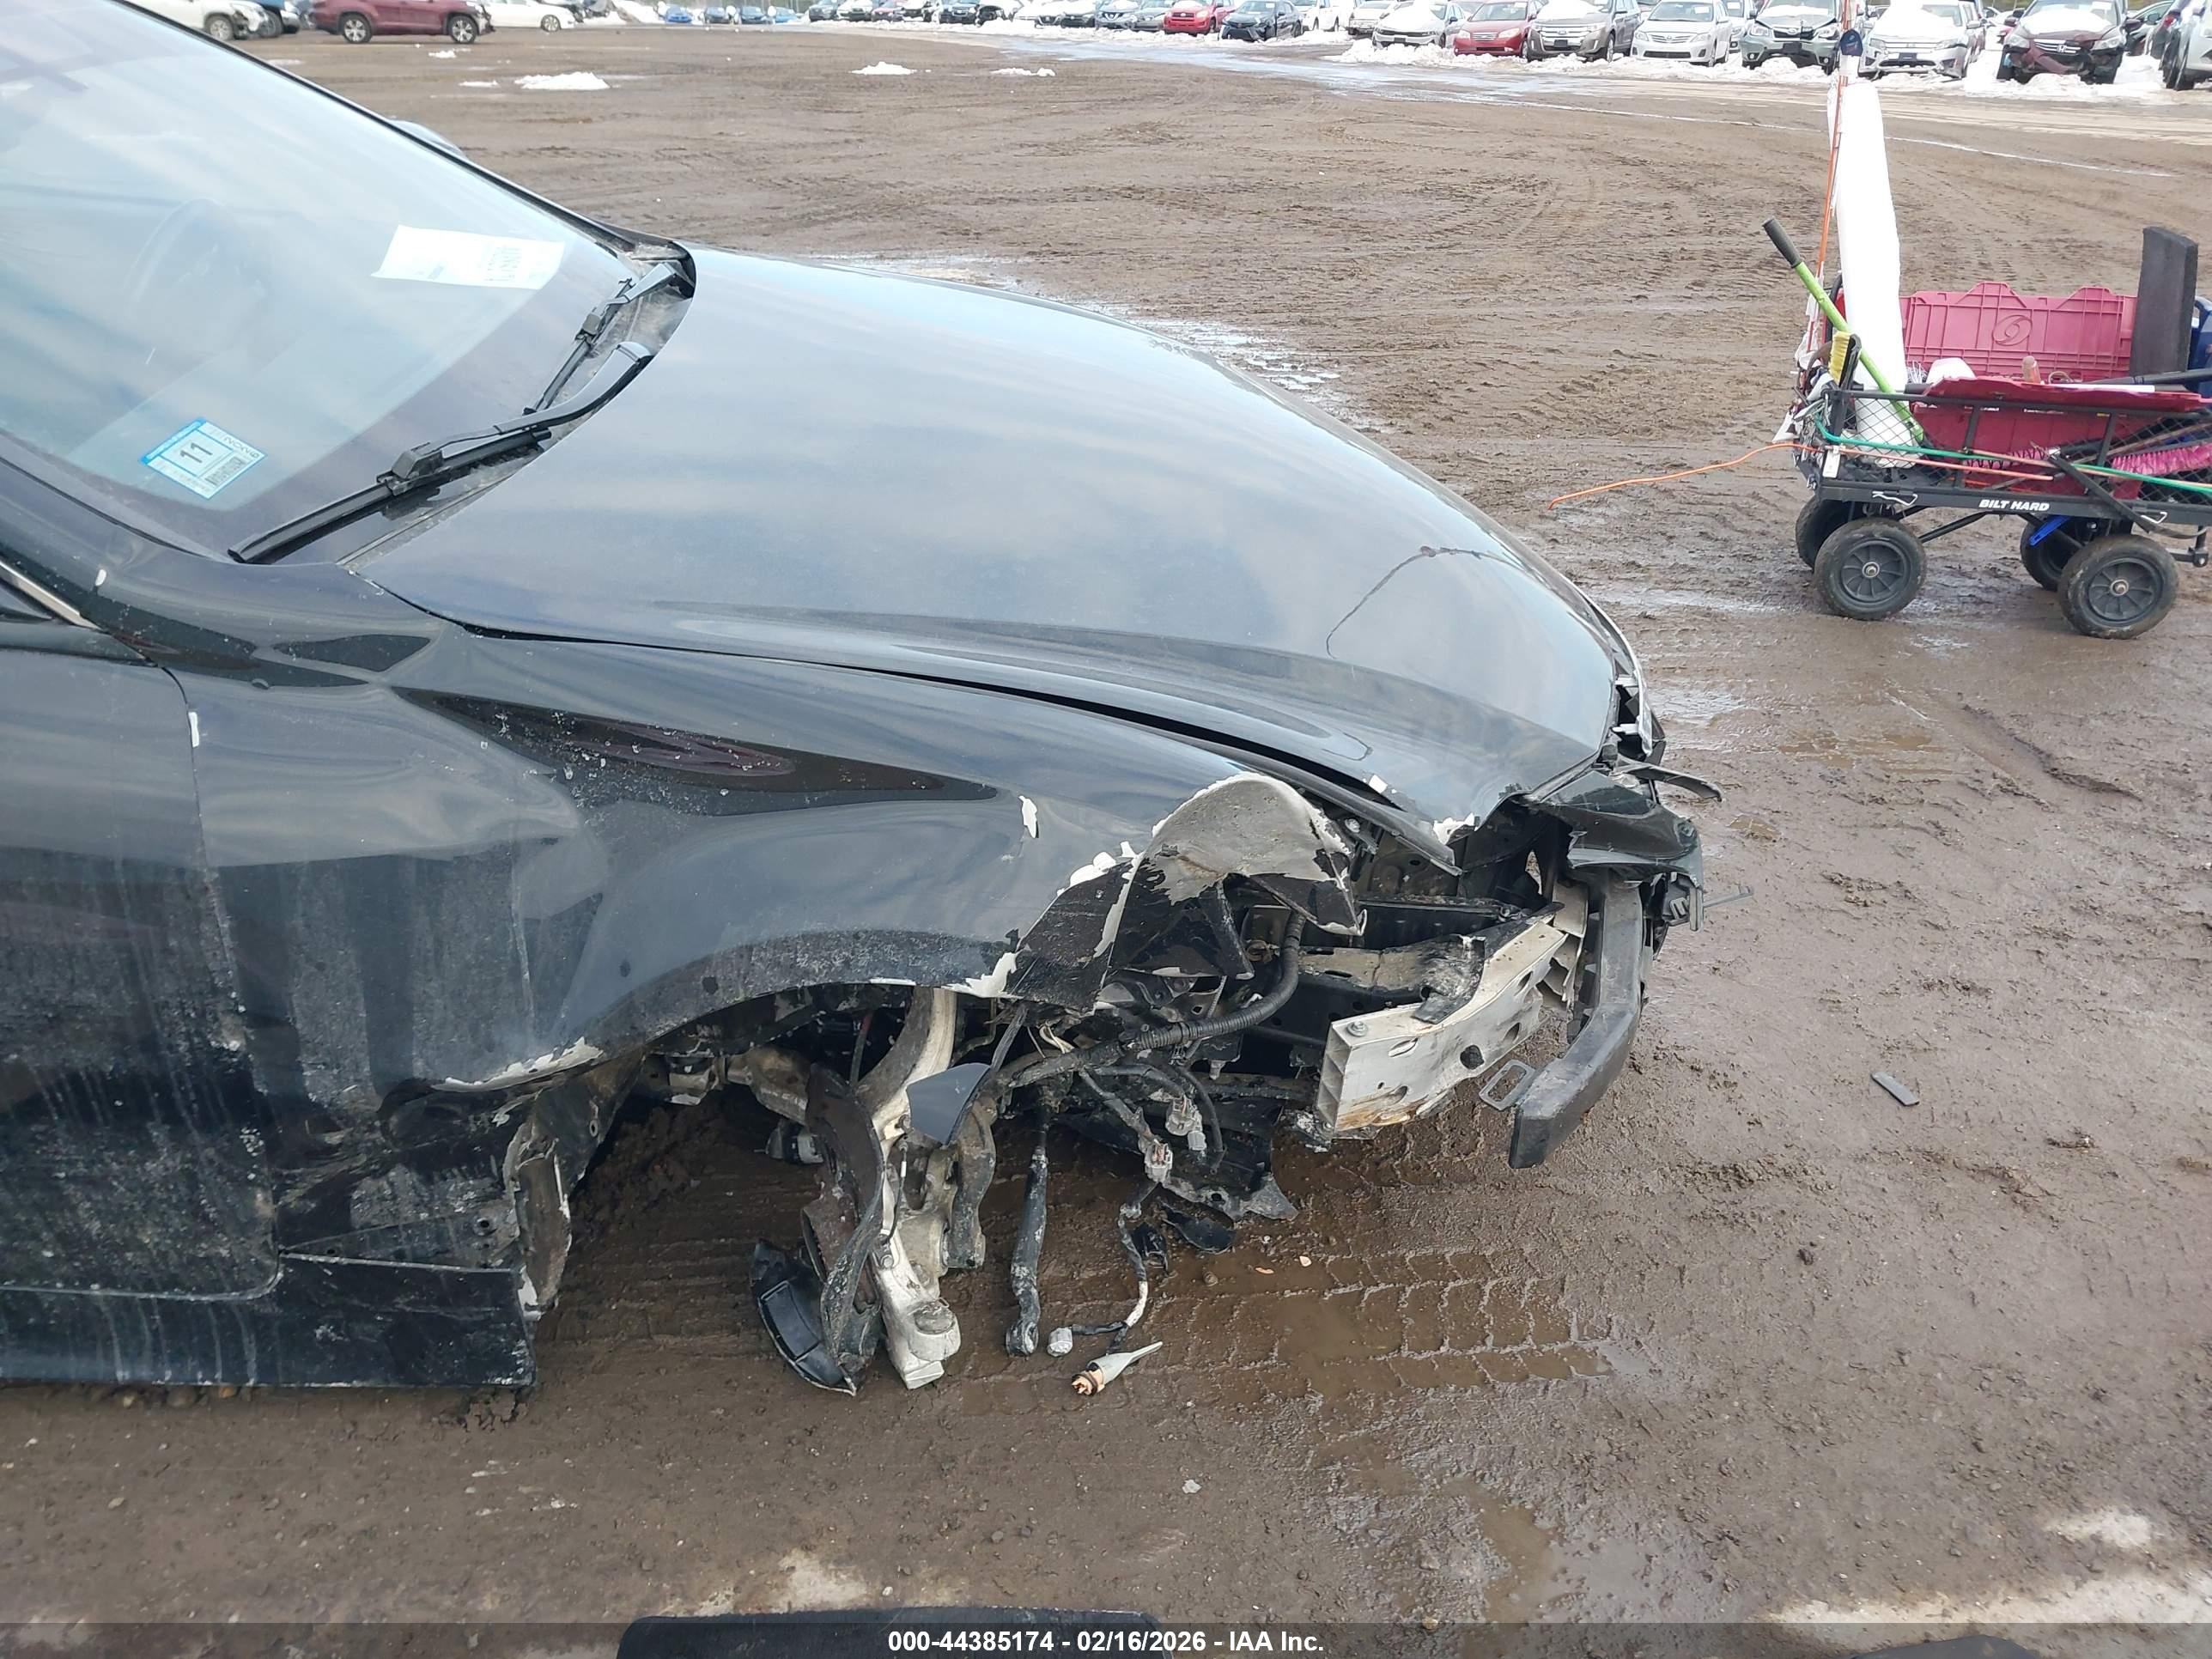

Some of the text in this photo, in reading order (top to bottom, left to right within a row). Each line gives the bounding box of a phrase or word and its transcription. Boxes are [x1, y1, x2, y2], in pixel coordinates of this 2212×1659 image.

[179, 442, 213, 464] 11
[1978, 499, 2051, 512] BILT HARD
